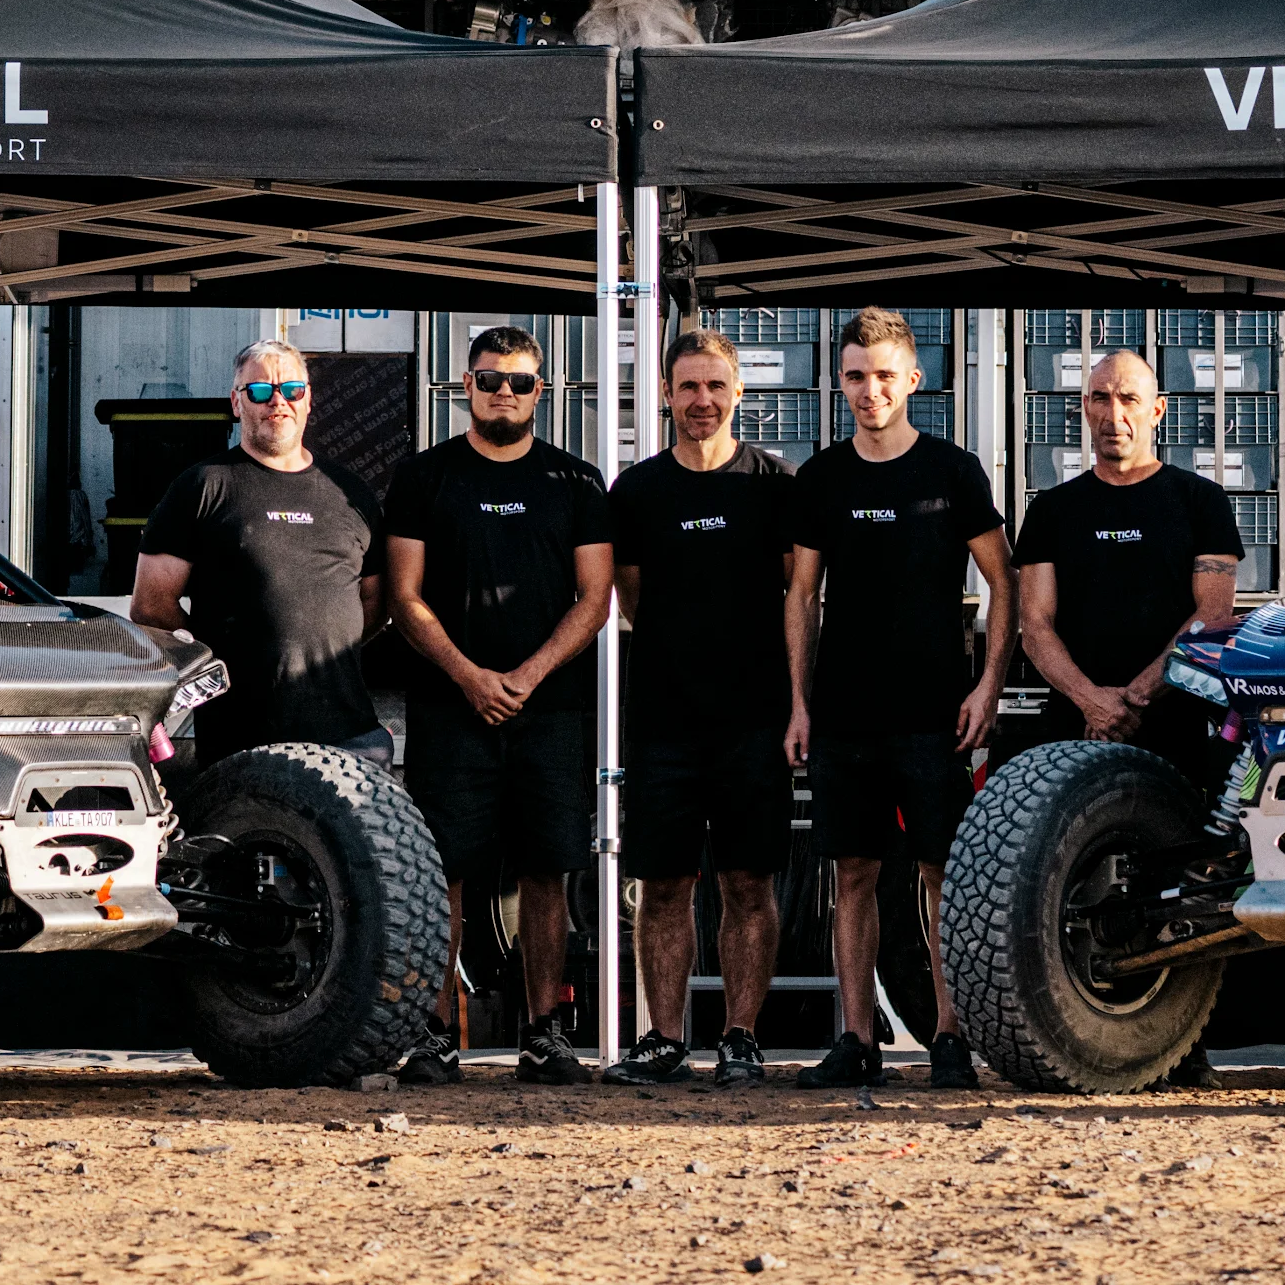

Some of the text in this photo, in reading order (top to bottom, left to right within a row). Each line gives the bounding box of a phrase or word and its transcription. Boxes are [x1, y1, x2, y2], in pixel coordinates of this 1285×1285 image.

[480, 502, 526, 513] VERTICAL
[267, 511, 314, 521] VERTICAL
[852, 510, 896, 519] VERTICAL
[681, 516, 726, 530] VERTICAL
[1095, 529, 1142, 539] VERTICAL
[1225, 678, 1251, 696] VR
[1249, 684, 1277, 696] VAOS
[54, 813, 75, 826] KLE
[81, 813, 97, 826] TA
